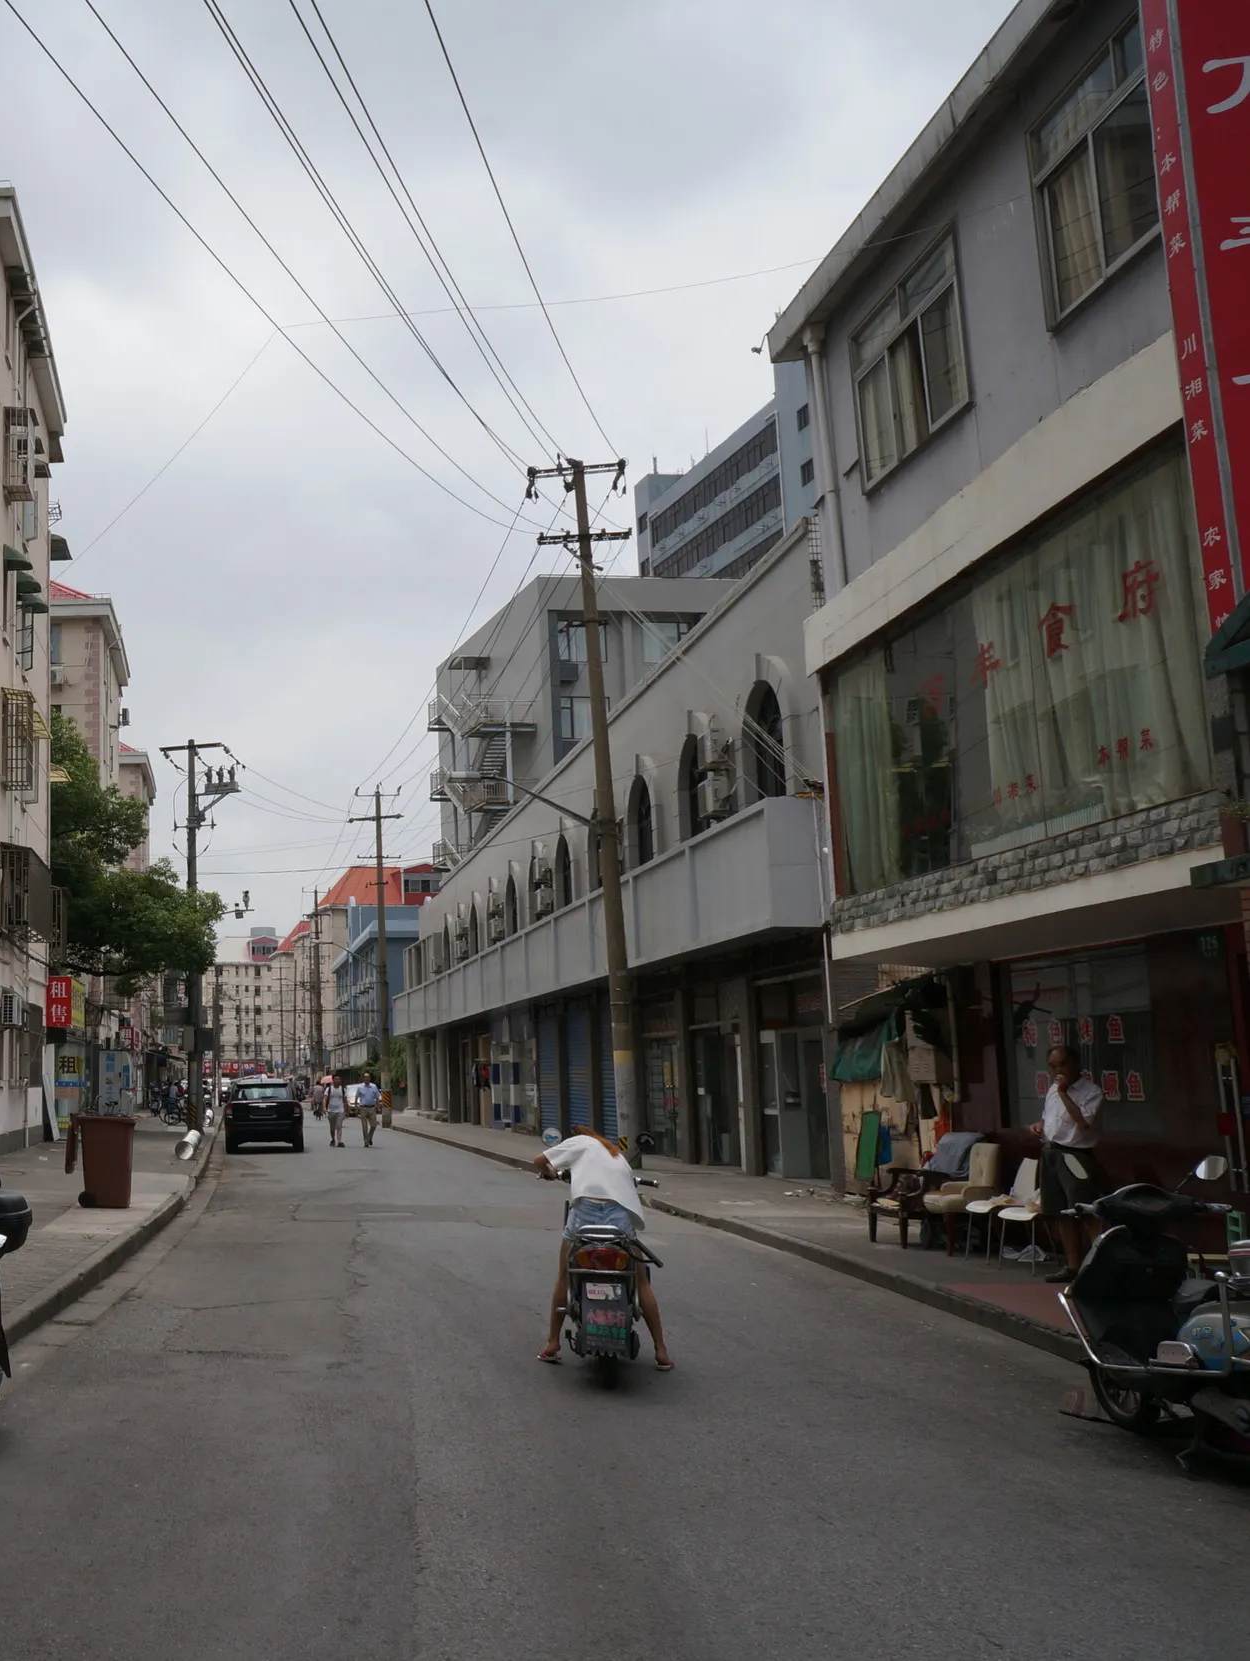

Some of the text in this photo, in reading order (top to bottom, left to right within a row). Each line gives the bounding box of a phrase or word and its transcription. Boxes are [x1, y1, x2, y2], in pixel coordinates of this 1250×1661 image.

[1181, 333, 1208, 444] 川湘菜
[50, 981, 68, 1023] 租售
[58, 1055, 78, 1075] 租
